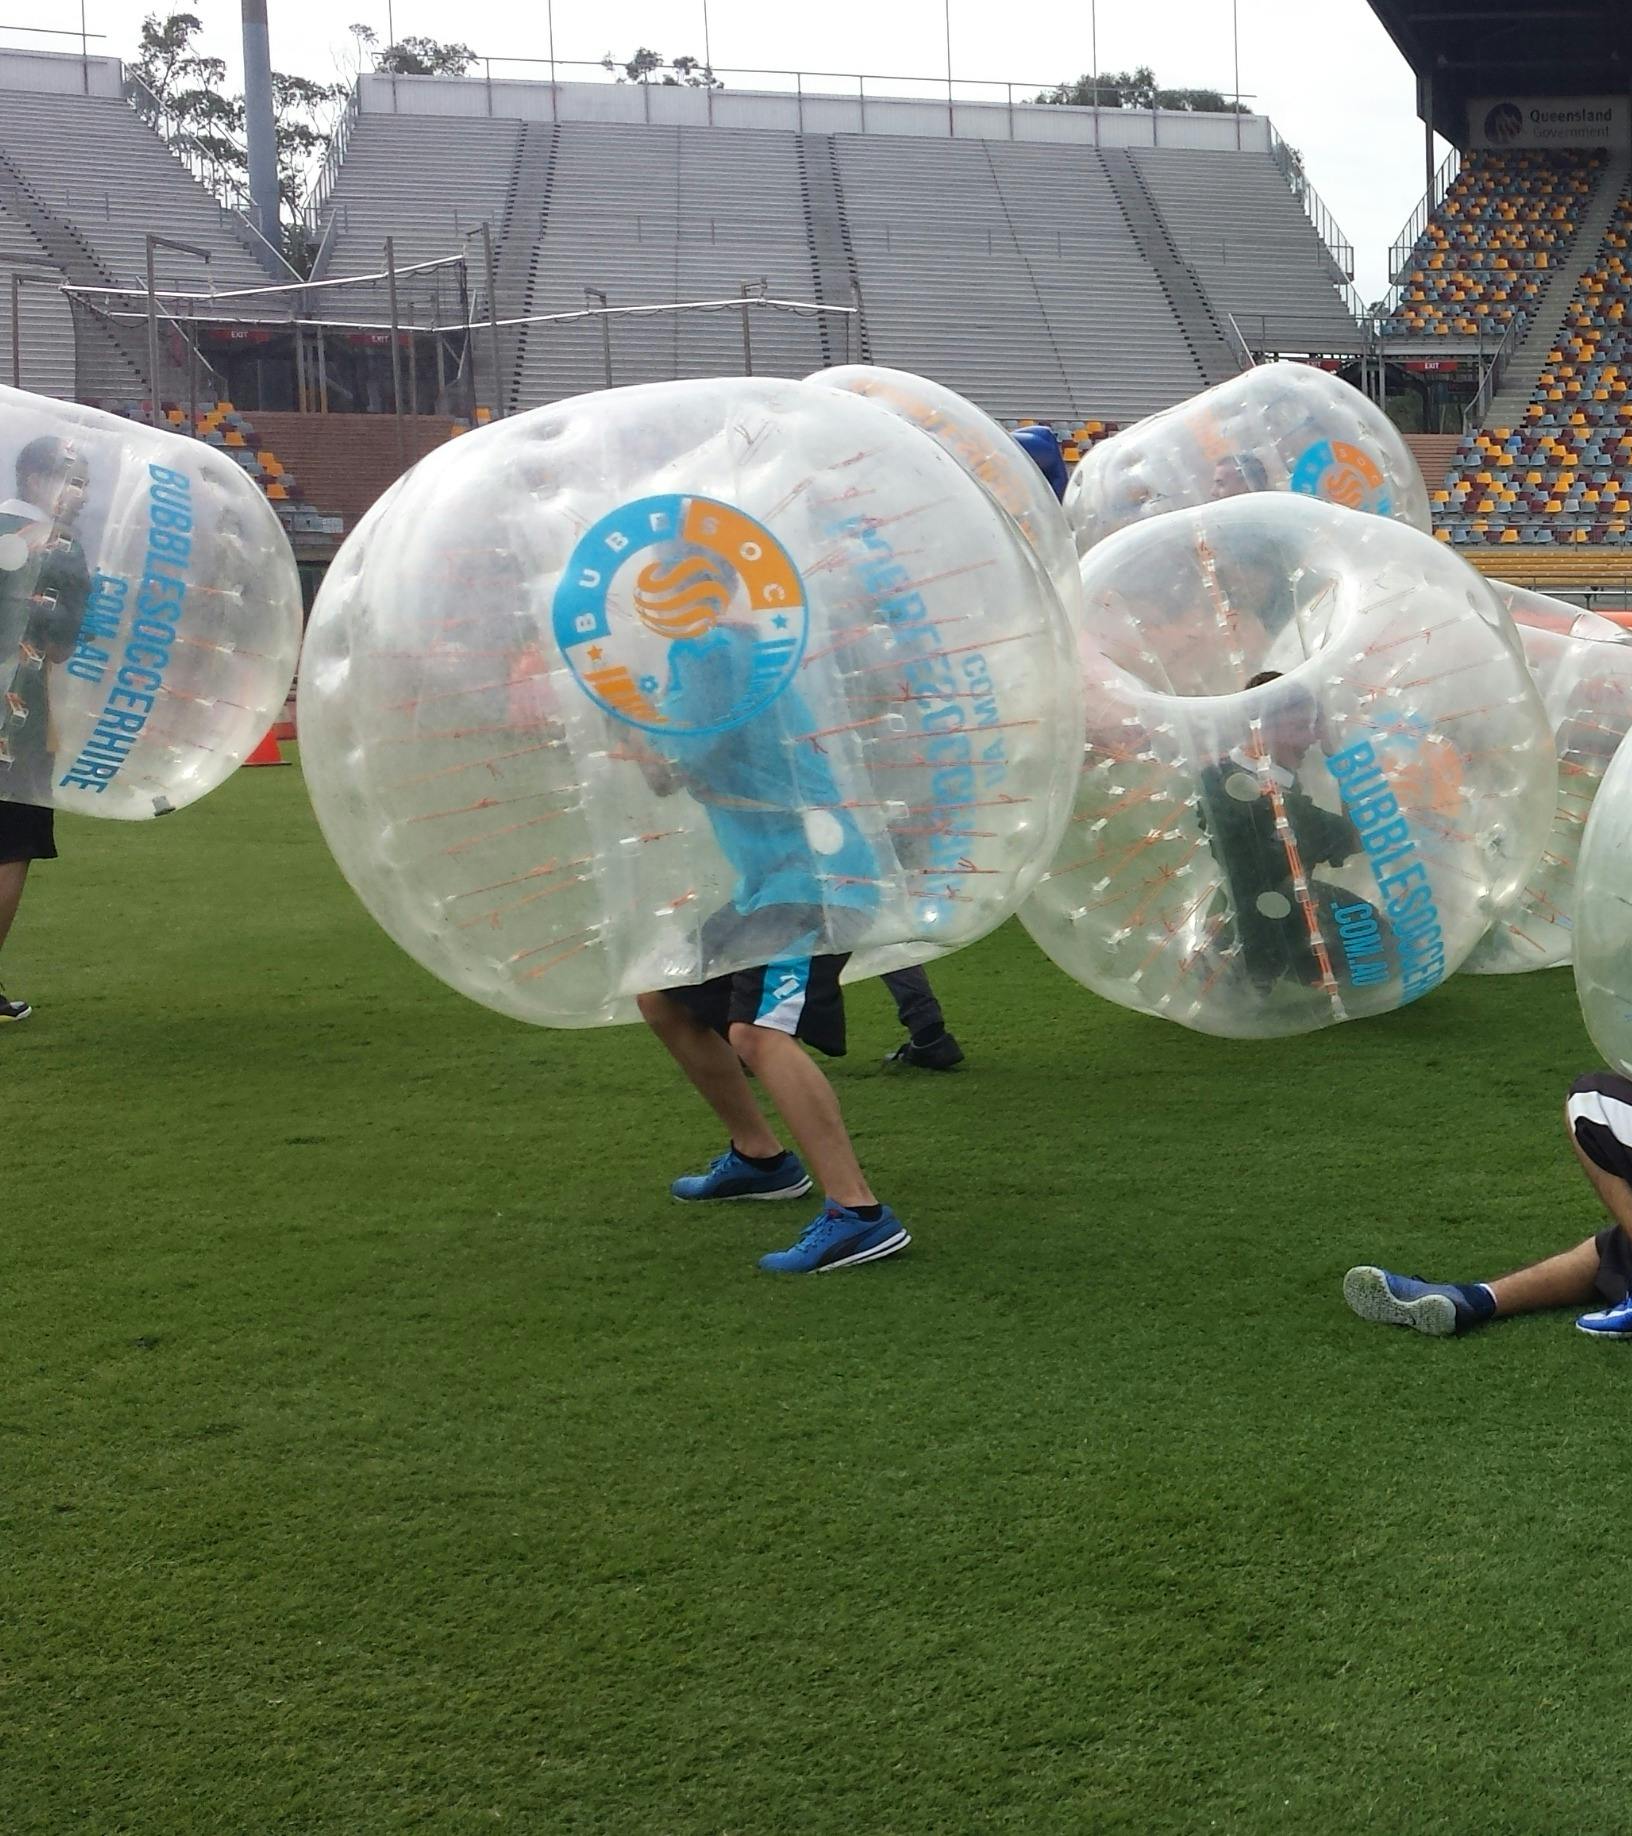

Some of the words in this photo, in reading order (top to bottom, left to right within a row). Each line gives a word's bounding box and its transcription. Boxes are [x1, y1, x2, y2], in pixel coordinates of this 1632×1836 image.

[1530, 108, 1612, 123] Queensland
[1533, 126, 1609, 138] Government
[372, 335, 389, 343] EXIT
[60, 463, 193, 794] BUBBLESOCCERHIRE
